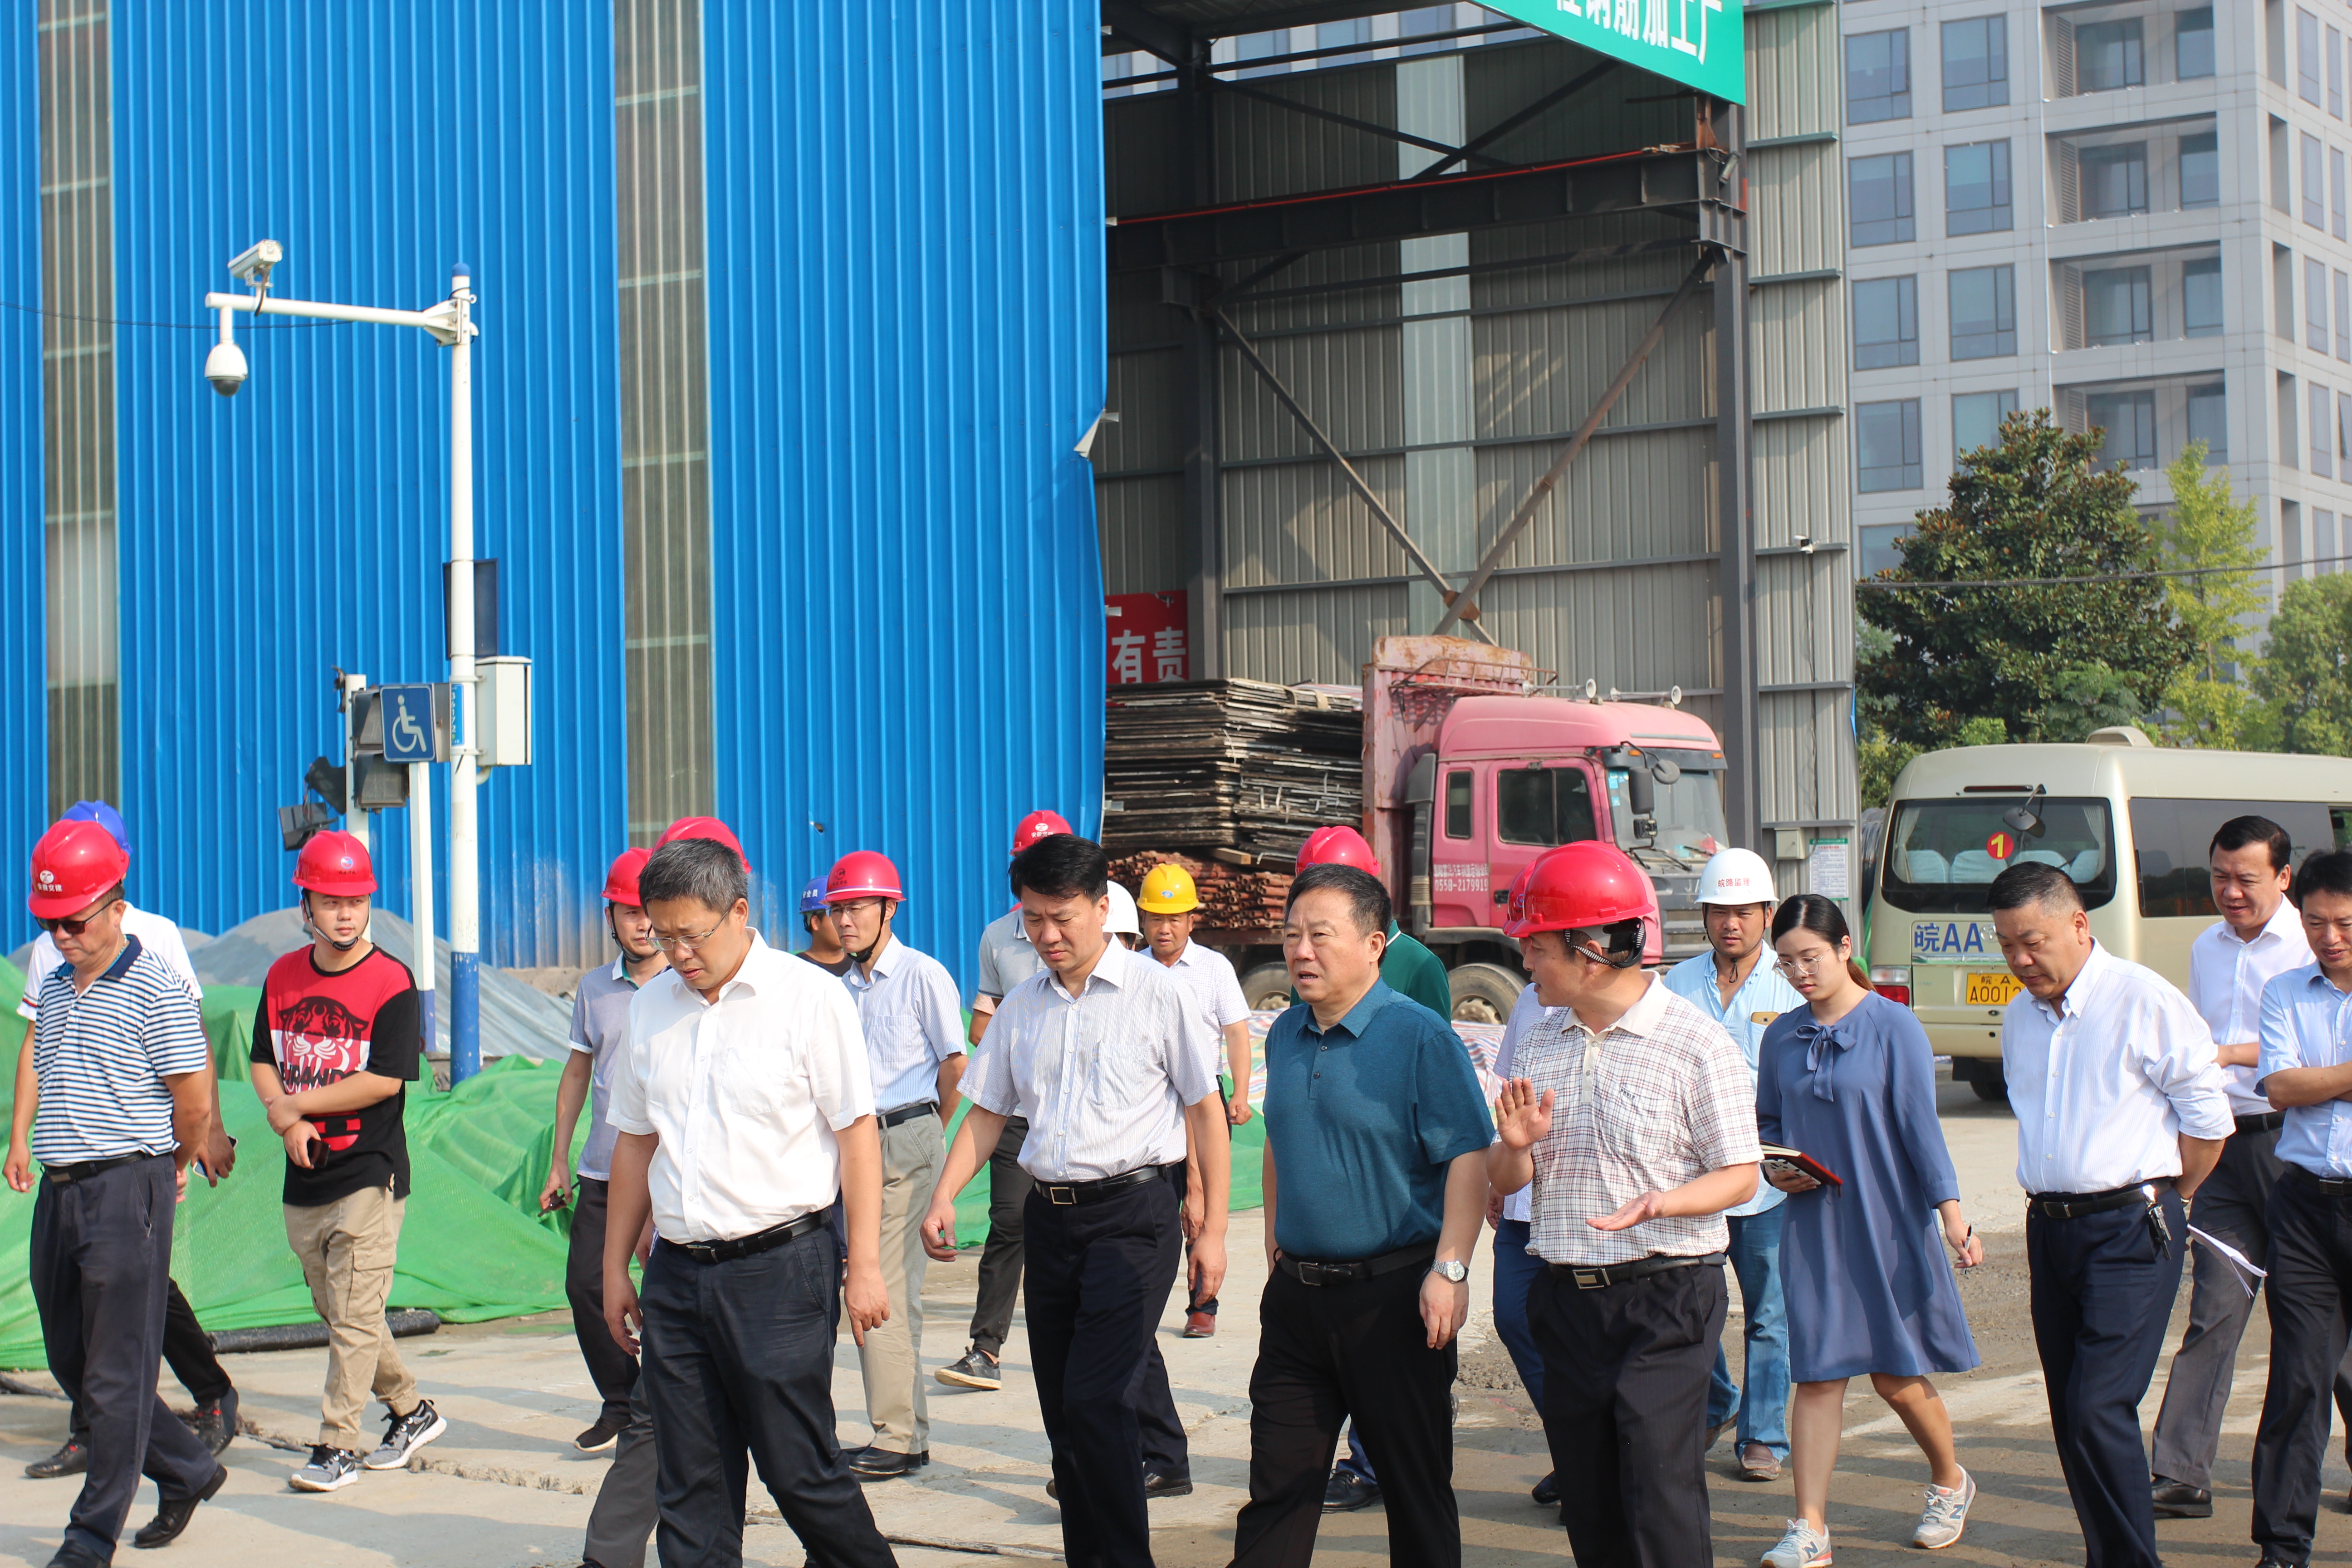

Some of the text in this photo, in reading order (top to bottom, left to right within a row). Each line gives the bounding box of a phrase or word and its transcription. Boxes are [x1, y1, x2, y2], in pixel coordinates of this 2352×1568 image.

[1556, 0, 1722, 65] 筋加工厂
[1112, 627, 1186, 684] 有责
[1991, 834, 2004, 858] 1
[1718, 878, 1750, 888] 皖路监理
[1914, 923, 1984, 952] 皖AA
